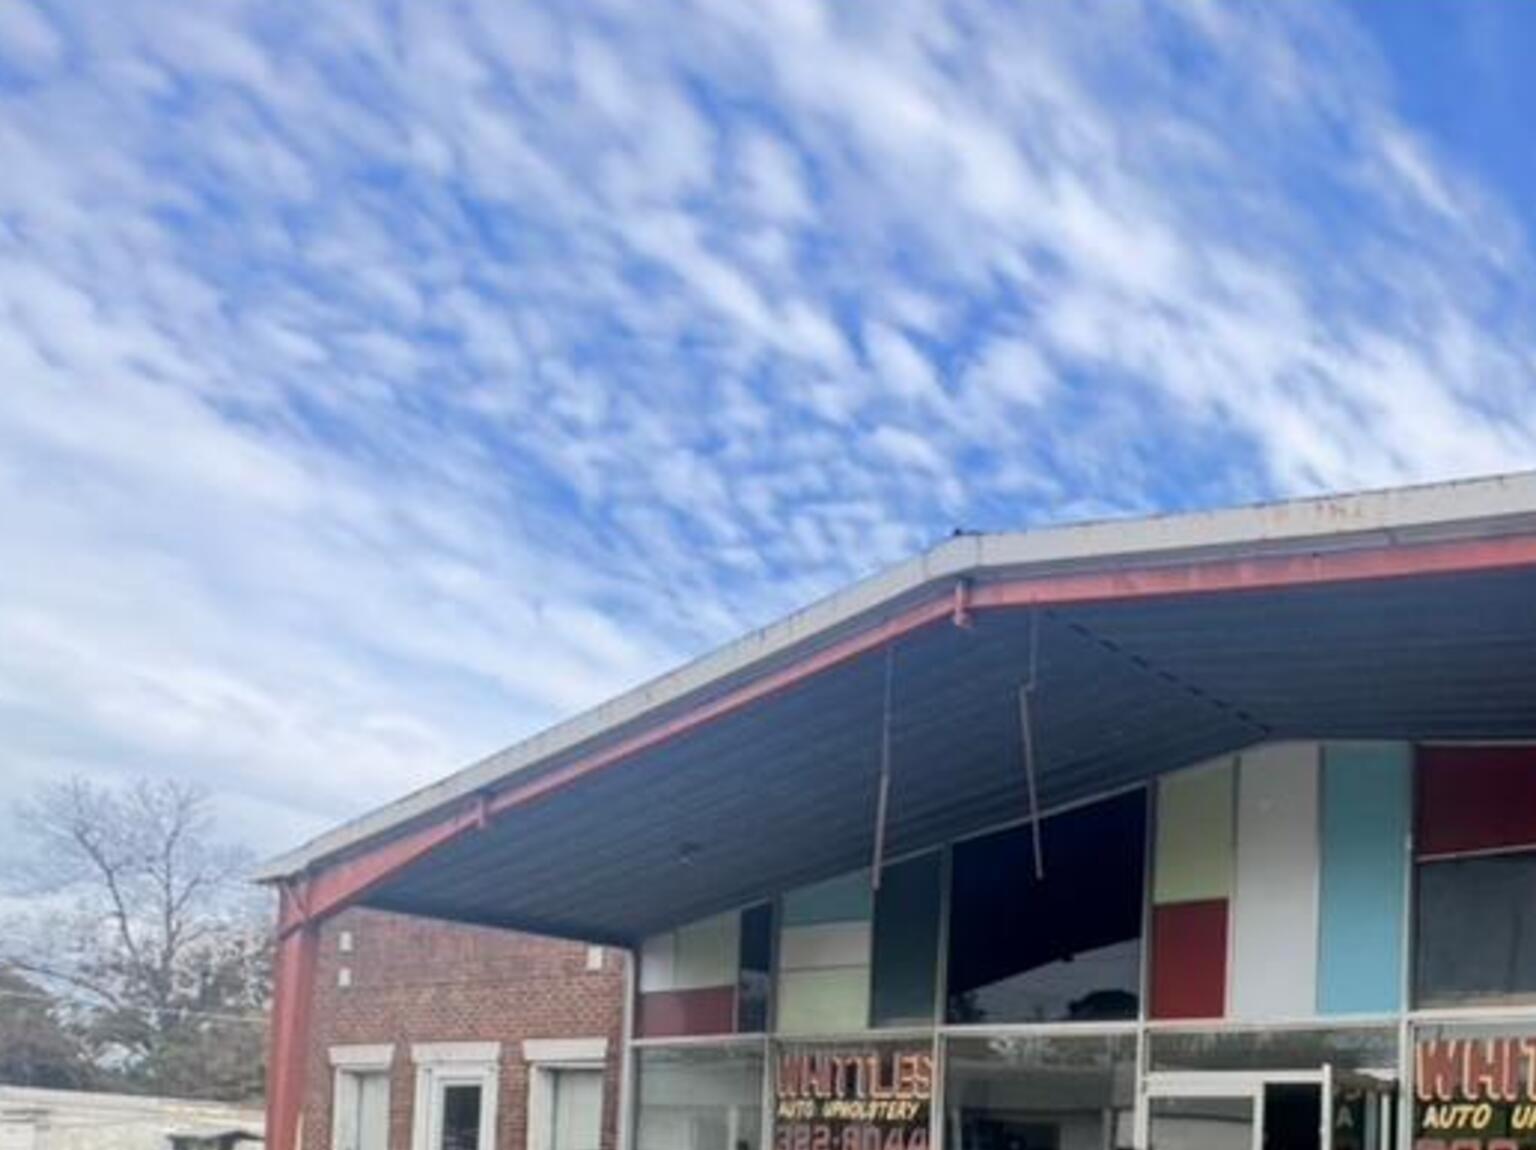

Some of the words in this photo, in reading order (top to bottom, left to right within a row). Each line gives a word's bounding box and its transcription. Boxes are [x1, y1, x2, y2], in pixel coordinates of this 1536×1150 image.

[776, 1053, 933, 1098] WHITTLES
[778, 1101, 815, 1119] AUTO
[822, 1100, 920, 1121] UPHOLSTERY
[1423, 1104, 1491, 1128] AUTO
